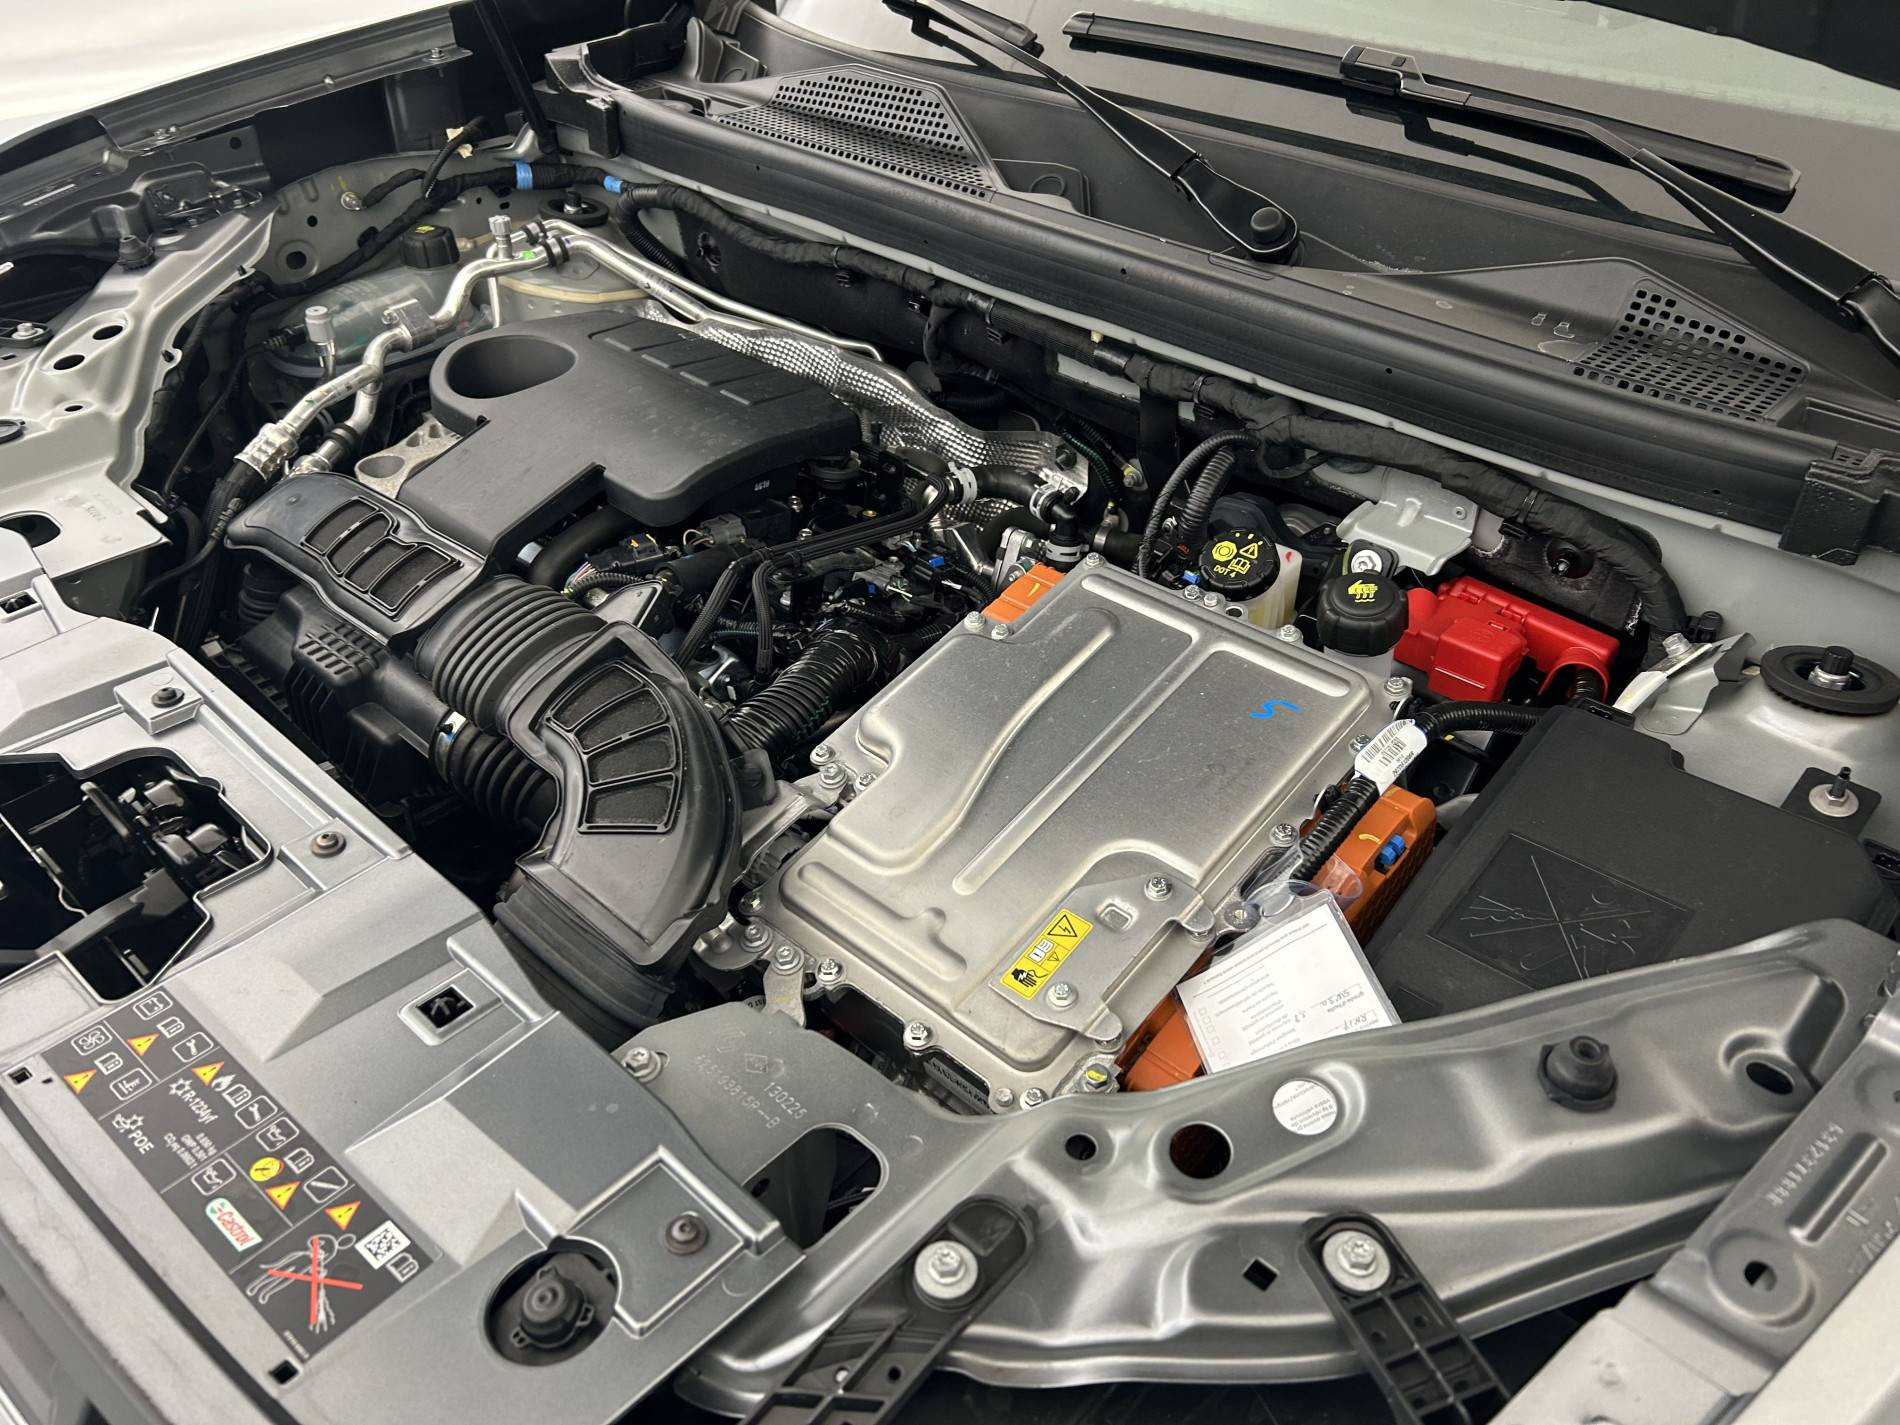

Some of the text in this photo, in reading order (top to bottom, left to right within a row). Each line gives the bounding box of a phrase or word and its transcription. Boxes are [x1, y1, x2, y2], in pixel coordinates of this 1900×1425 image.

[1213, 564, 1231, 576] DOT
[763, 1082, 808, 1120] 130225
[128, 1129, 155, 1155] POE
[216, 1208, 256, 1247] Castrol
